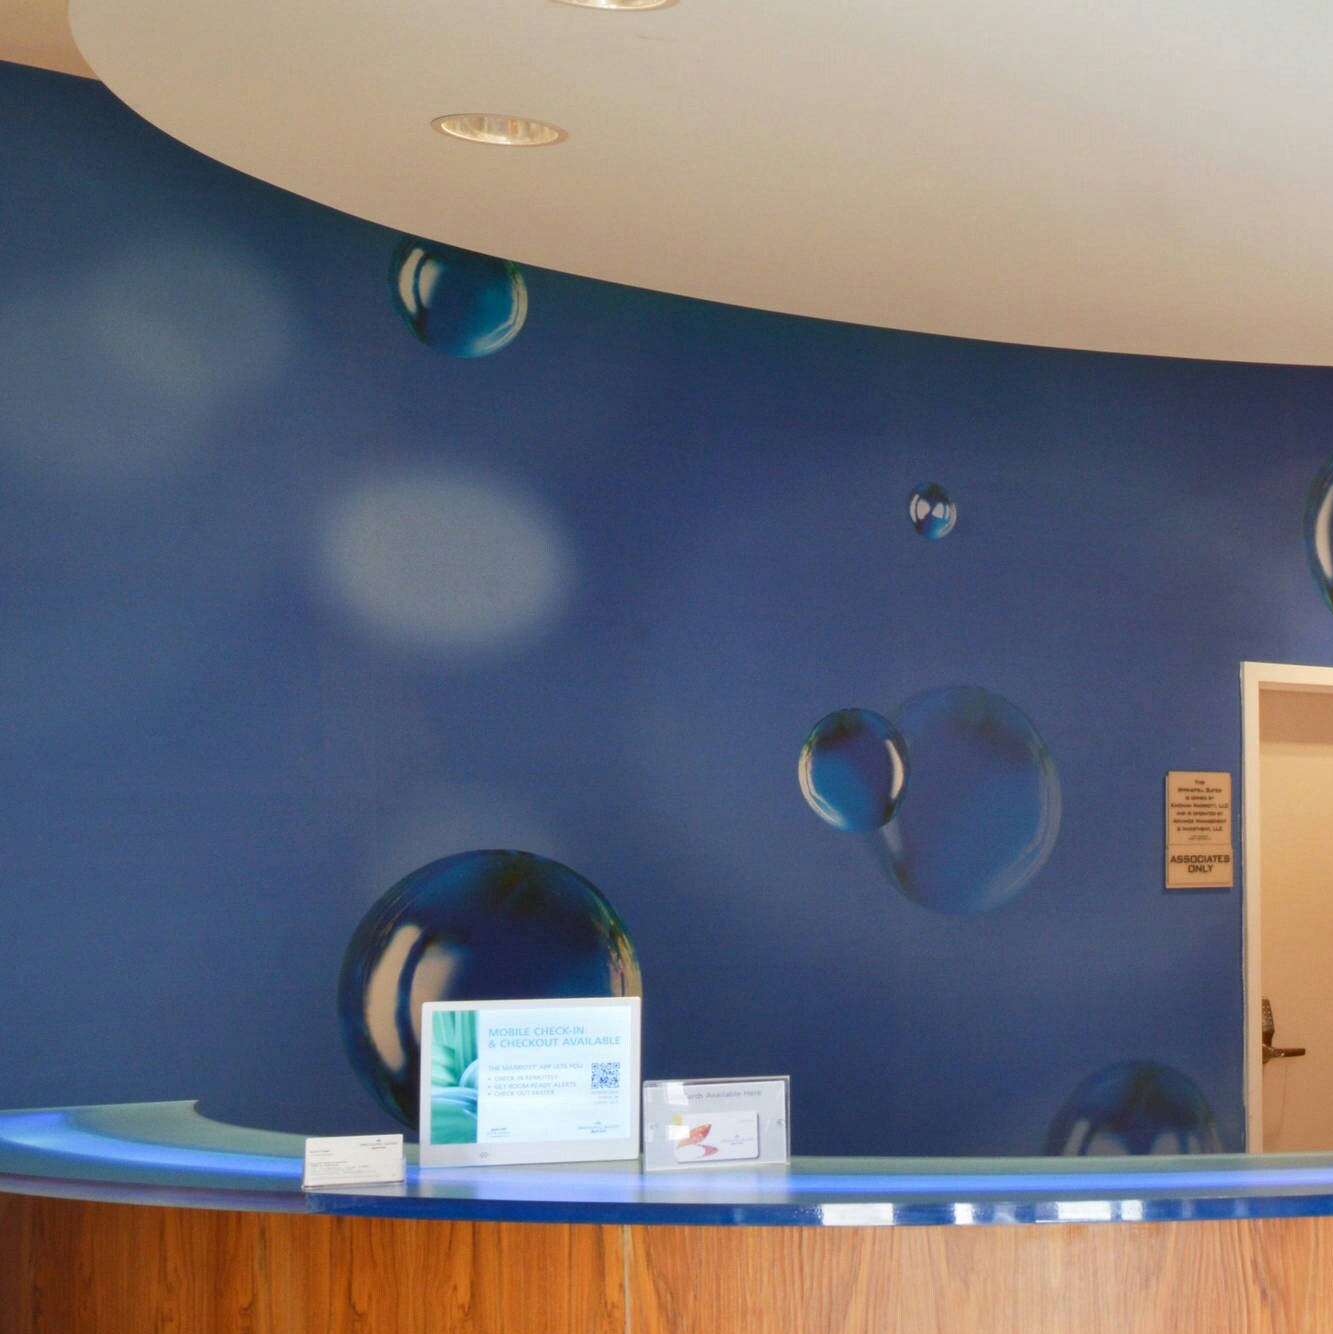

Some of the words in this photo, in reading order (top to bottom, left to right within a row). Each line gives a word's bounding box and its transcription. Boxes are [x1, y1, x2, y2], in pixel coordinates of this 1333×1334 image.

[1170, 854, 1230, 864] ASSOCIATES
[1187, 864, 1214, 873] ONLY
[488, 1027, 530, 1037] MOBILE
[533, 1025, 585, 1036] CHECK-IN
[487, 1039, 497, 1048] &
[499, 1038, 558, 1048] CHECKOUT
[562, 1036, 621, 1046] AVAILABLE
